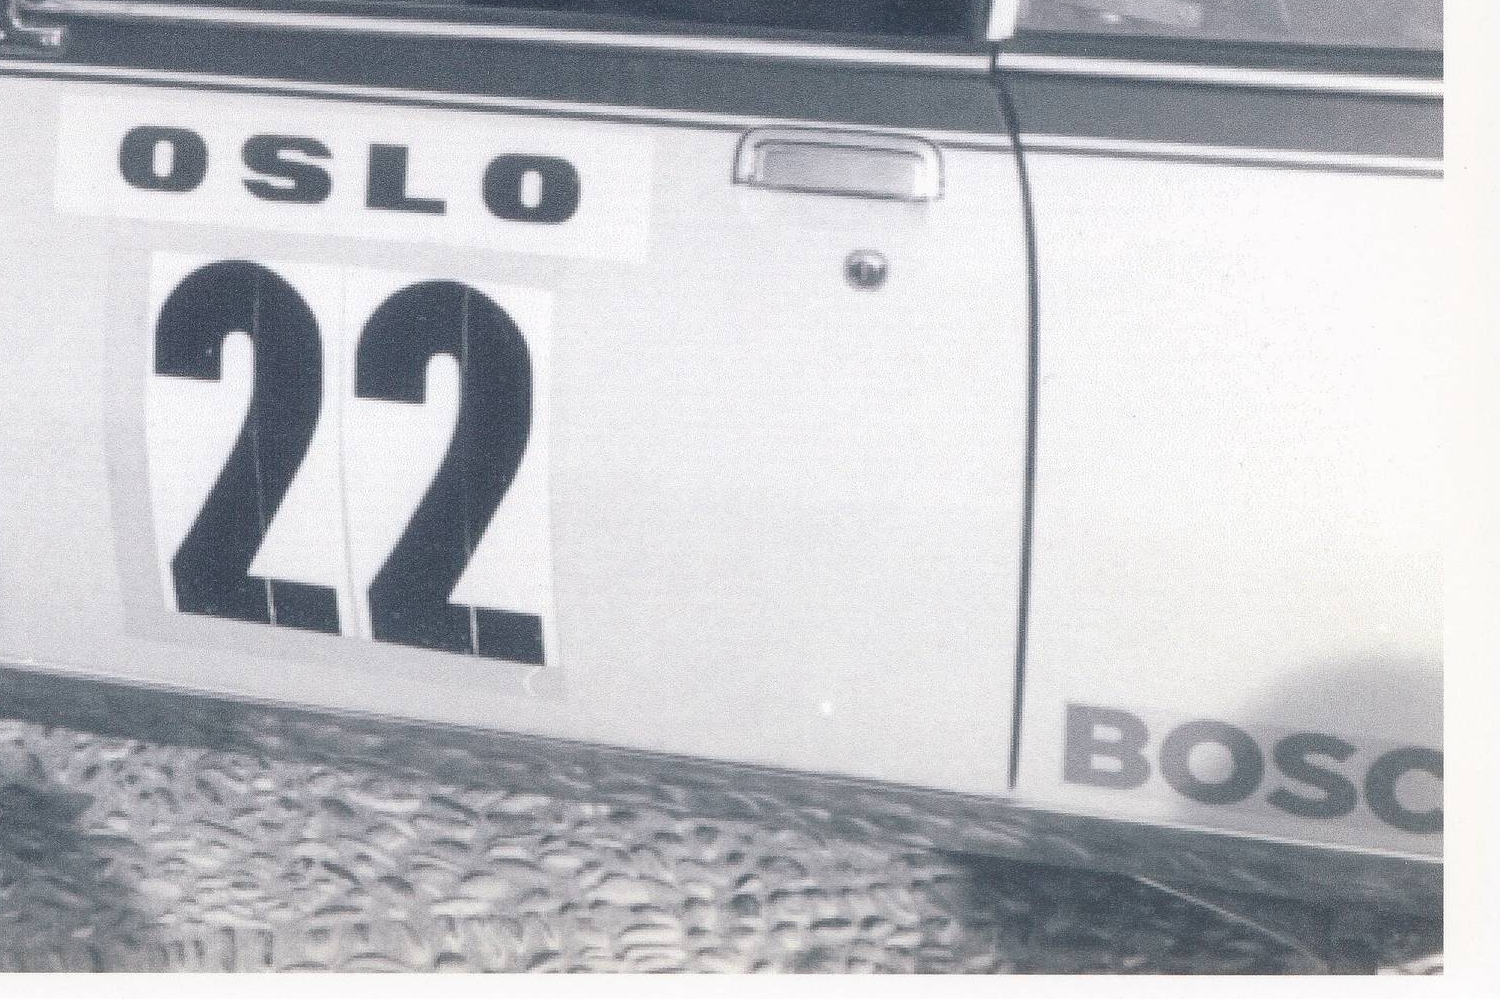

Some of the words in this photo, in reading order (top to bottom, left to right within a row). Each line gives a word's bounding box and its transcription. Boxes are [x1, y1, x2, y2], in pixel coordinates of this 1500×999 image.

[118, 123, 581, 225] OSLO
[153, 258, 546, 668] 22
[1062, 703, 1444, 835] BOSC
